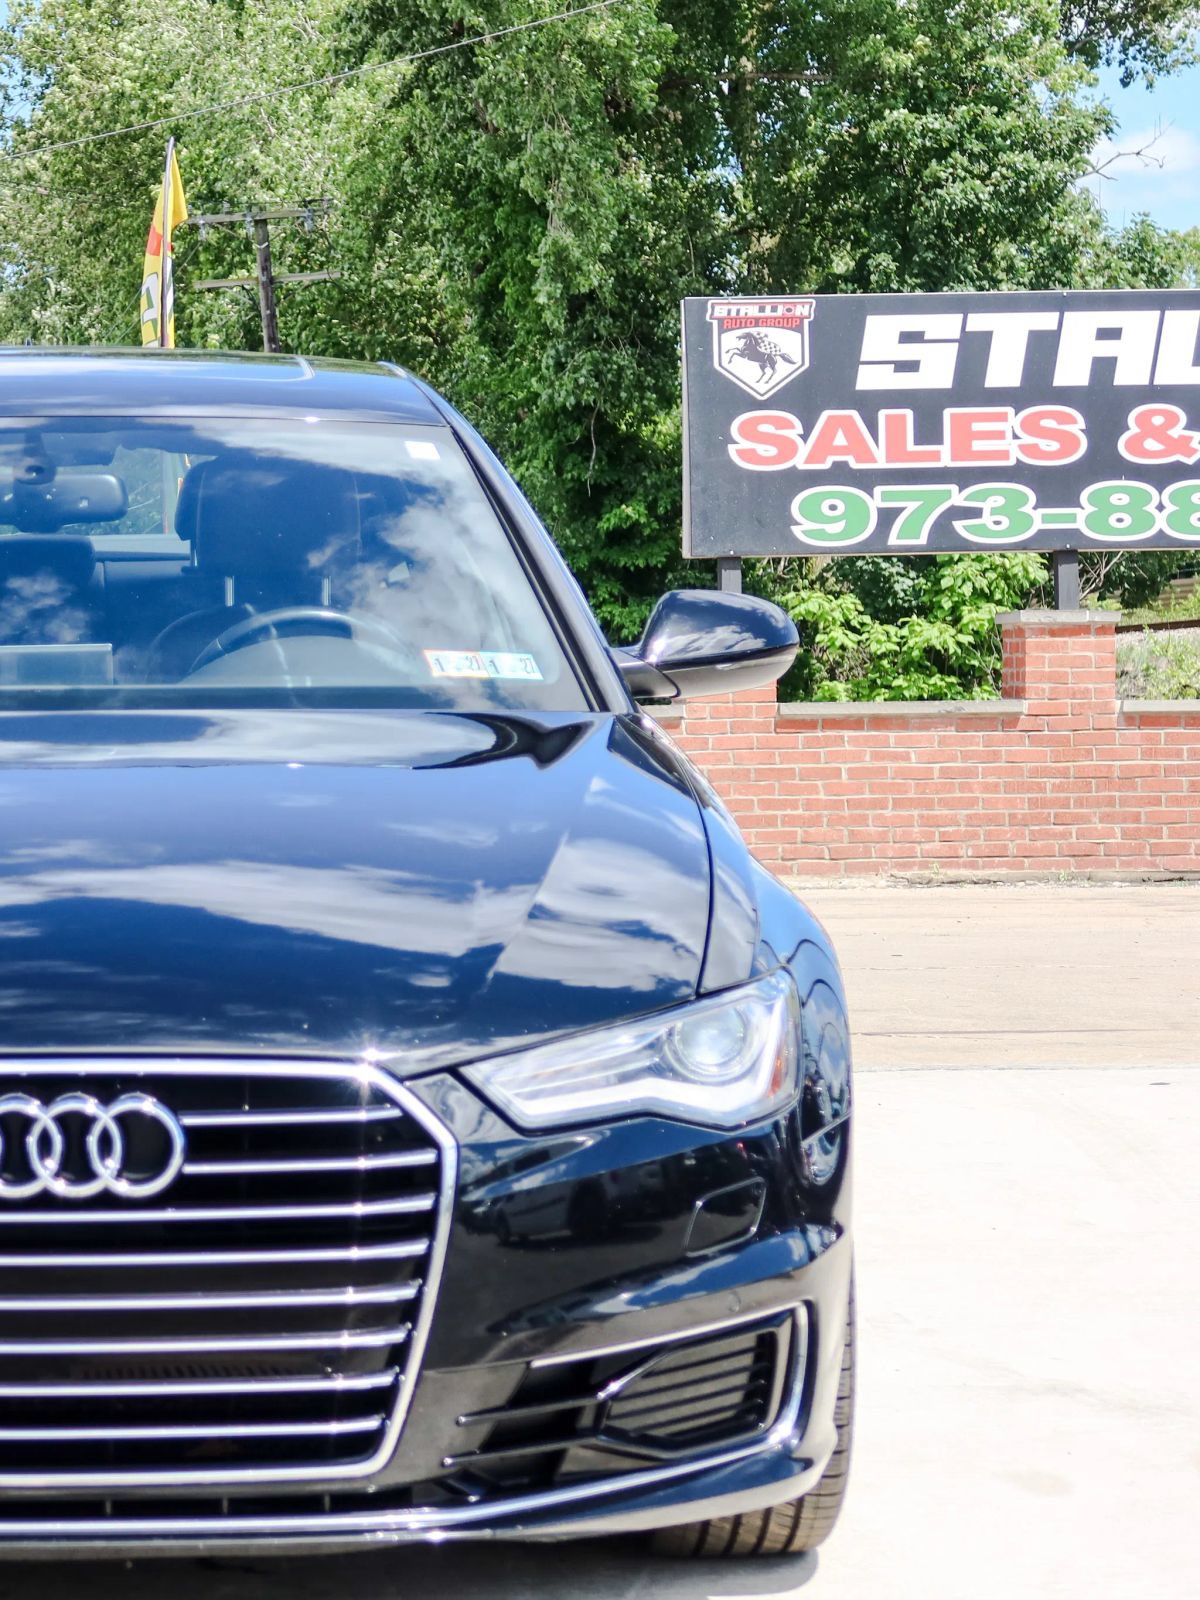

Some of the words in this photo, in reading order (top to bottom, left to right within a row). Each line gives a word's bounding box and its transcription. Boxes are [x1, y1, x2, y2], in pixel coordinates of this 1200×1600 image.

[712, 303, 811, 317] STALLION
[723, 318, 756, 329] AUTO
[758, 318, 800, 328] GROUP
[855, 310, 1200, 391] STAL
[728, 406, 1088, 471] SALES
[1118, 403, 1200, 465] &
